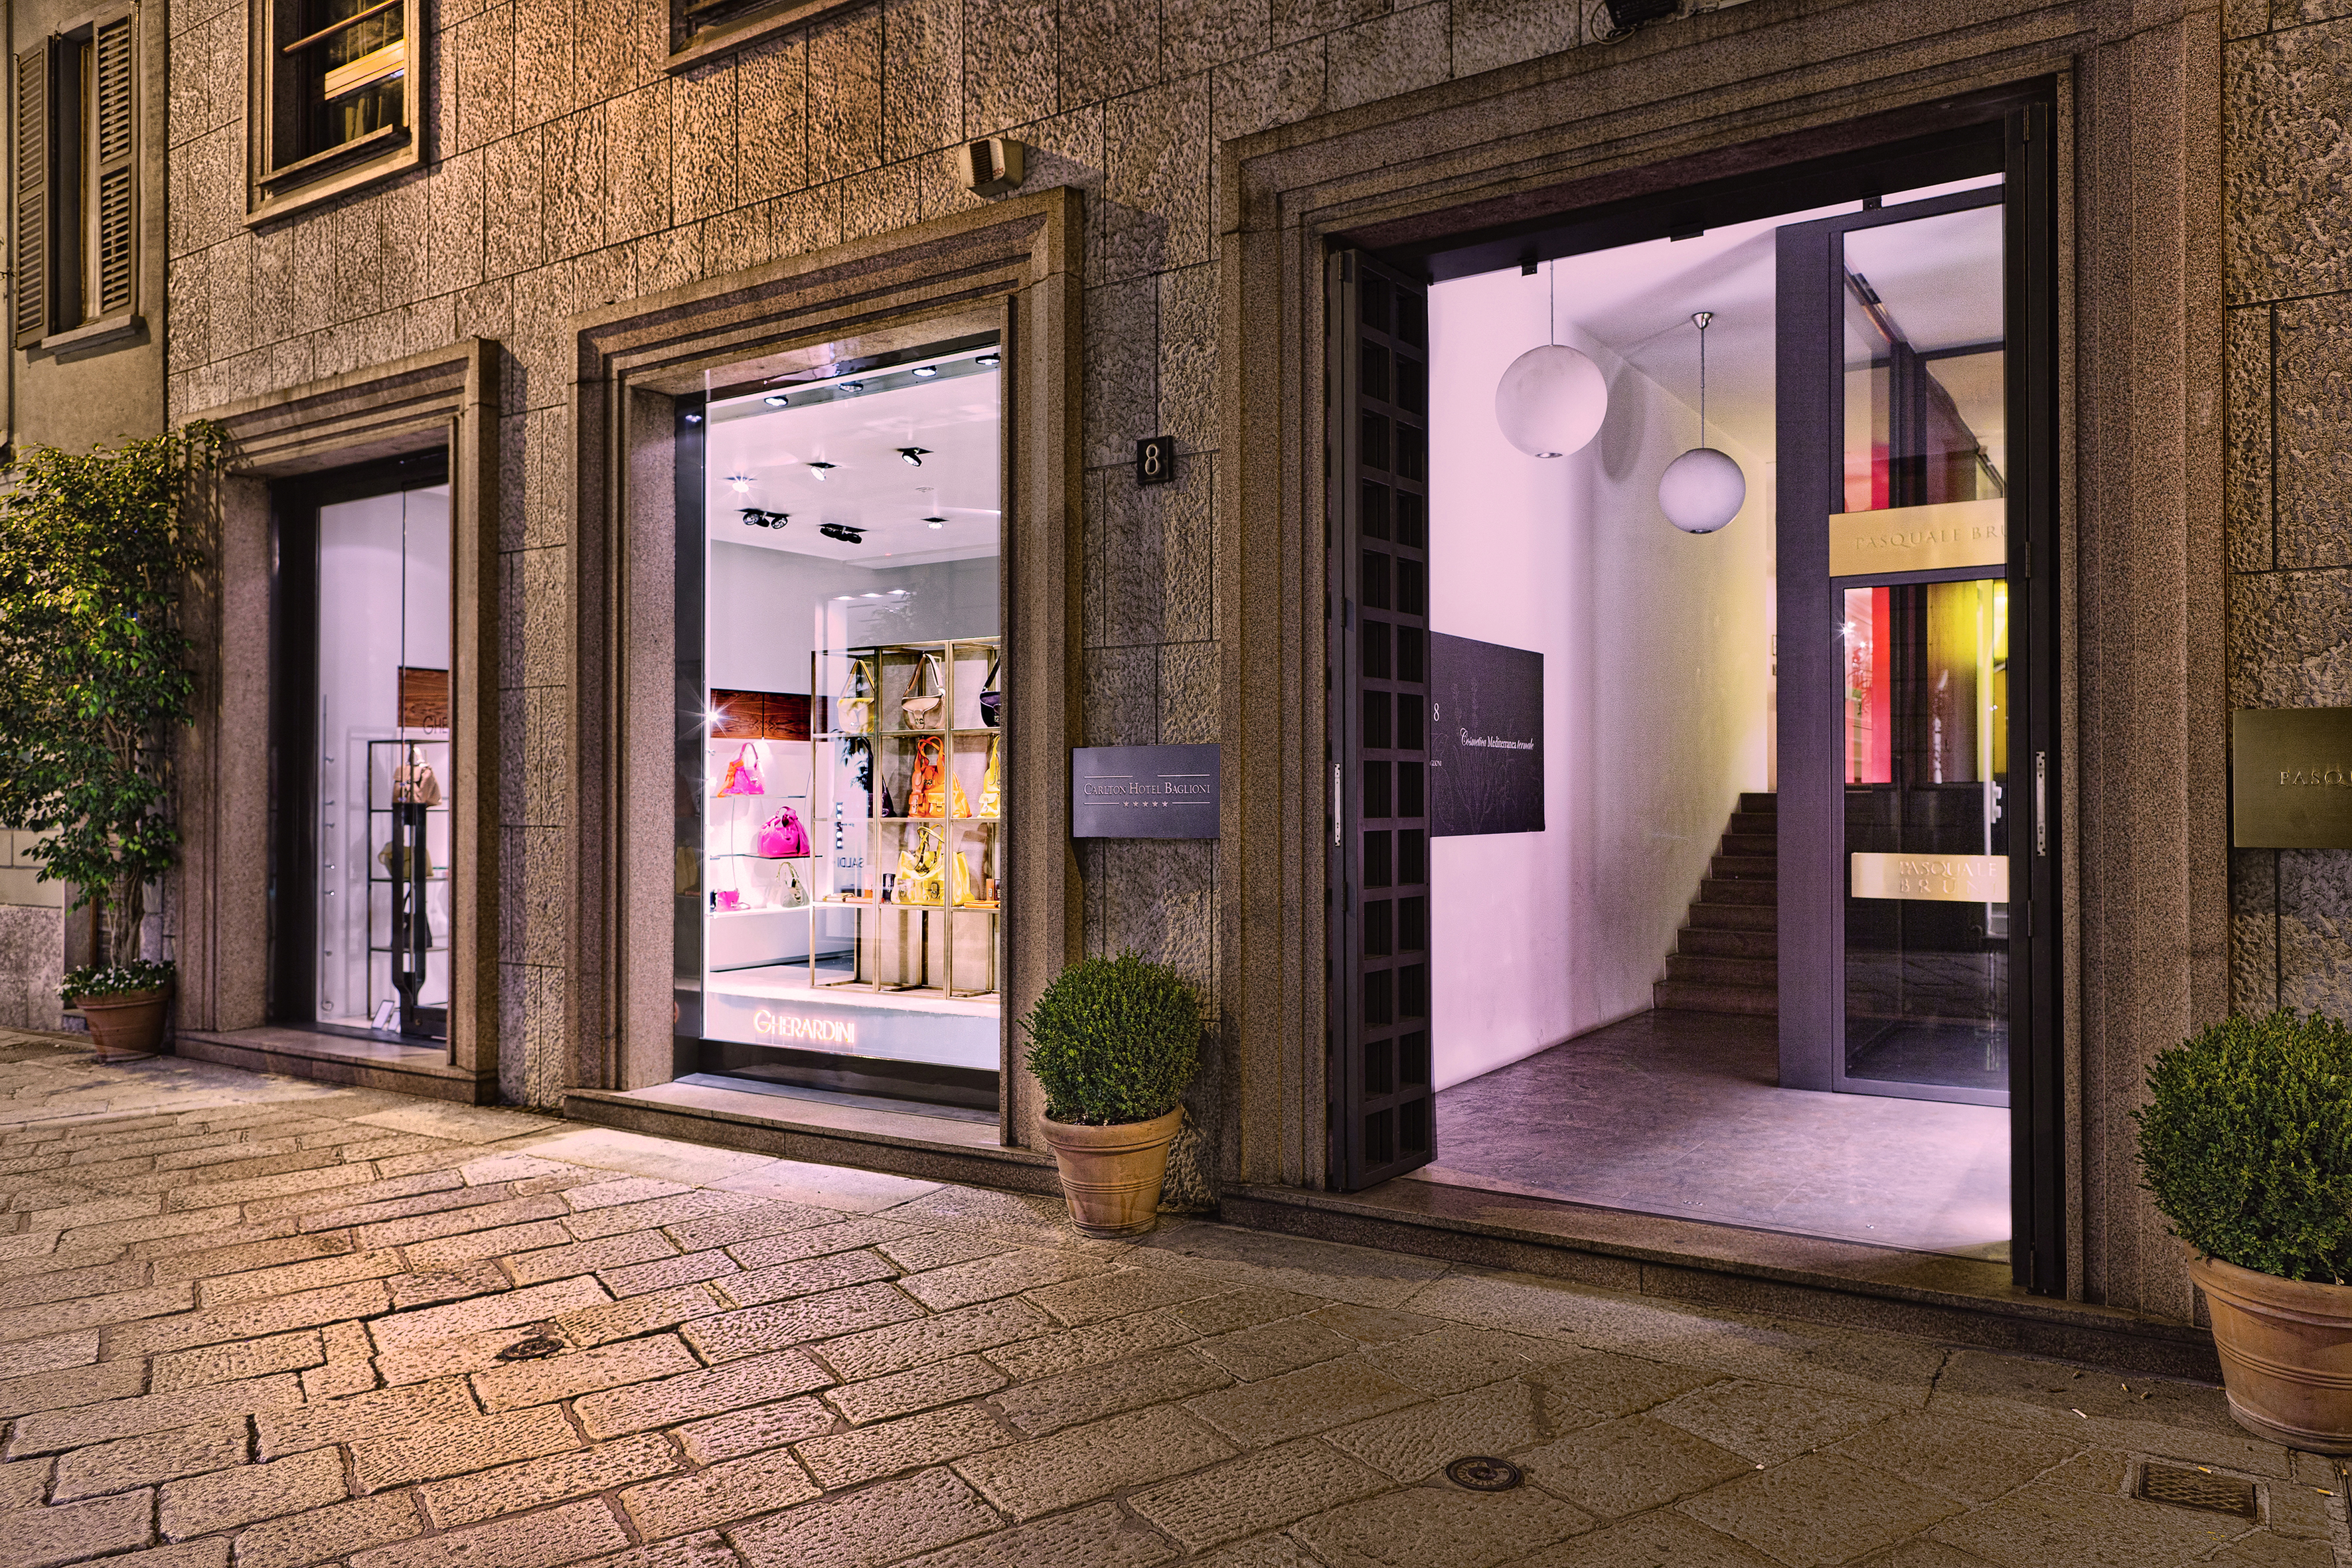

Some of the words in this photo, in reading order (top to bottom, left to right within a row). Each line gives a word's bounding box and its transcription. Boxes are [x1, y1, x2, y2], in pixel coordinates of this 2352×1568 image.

[1144, 443, 1160, 476] 8
[1855, 528, 1960, 550] PASQUALE
[1433, 702, 1440, 722] 8
[1460, 727, 1487, 747] Cosmetica
[1487, 735, 1517, 749] Mediterranea
[1083, 783, 1126, 795] CARLTON
[1129, 782, 1162, 795] HOTEL
[1164, 781, 1211, 795] BAGLIONI
[2280, 770, 2352, 787] PASQ
[1899, 860, 1998, 880] PASQUALE
[1900, 878, 1998, 895] BRUNI
[753, 1008, 856, 1044] GHERARDINI
